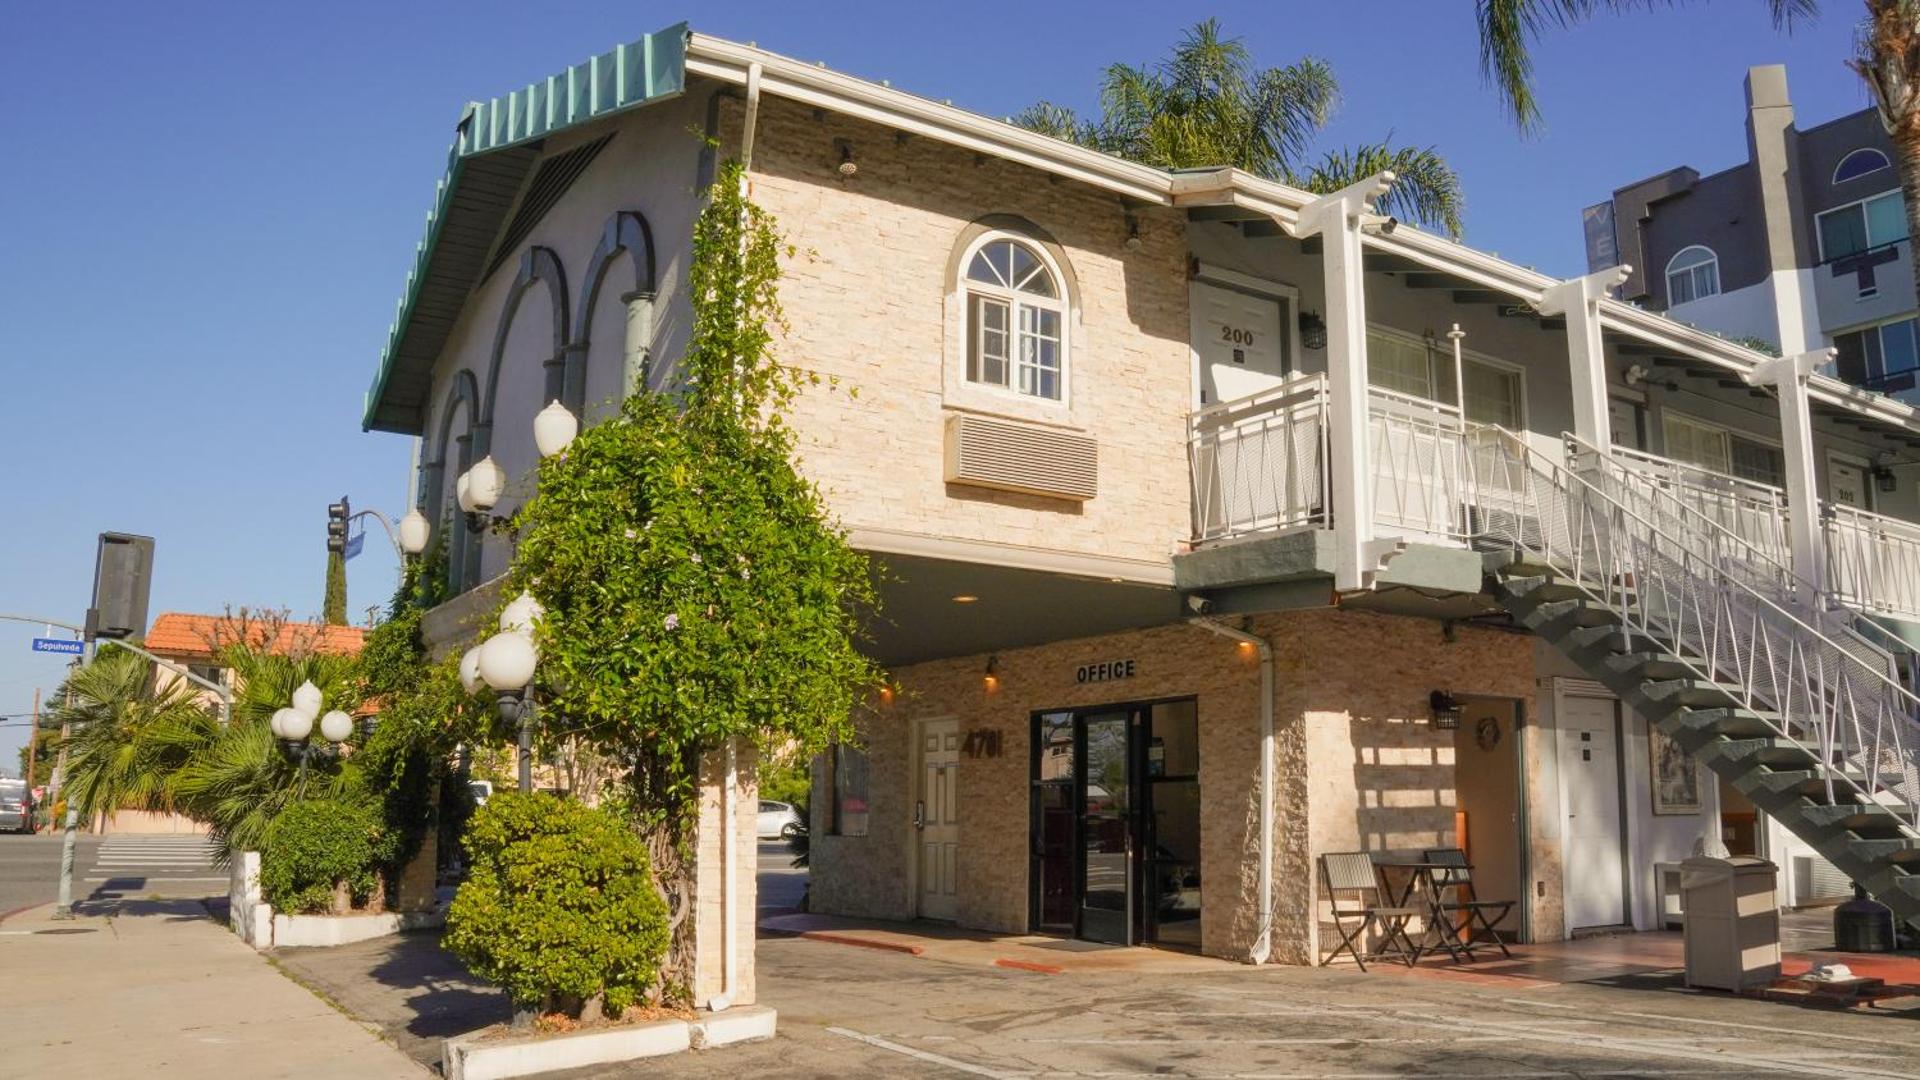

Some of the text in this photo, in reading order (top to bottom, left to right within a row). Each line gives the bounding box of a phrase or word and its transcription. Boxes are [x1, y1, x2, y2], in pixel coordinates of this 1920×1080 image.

[1222, 326, 1253, 346] 200
[37, 640, 80, 652] Sepulveda
[1077, 660, 1135, 682] OFFICE
